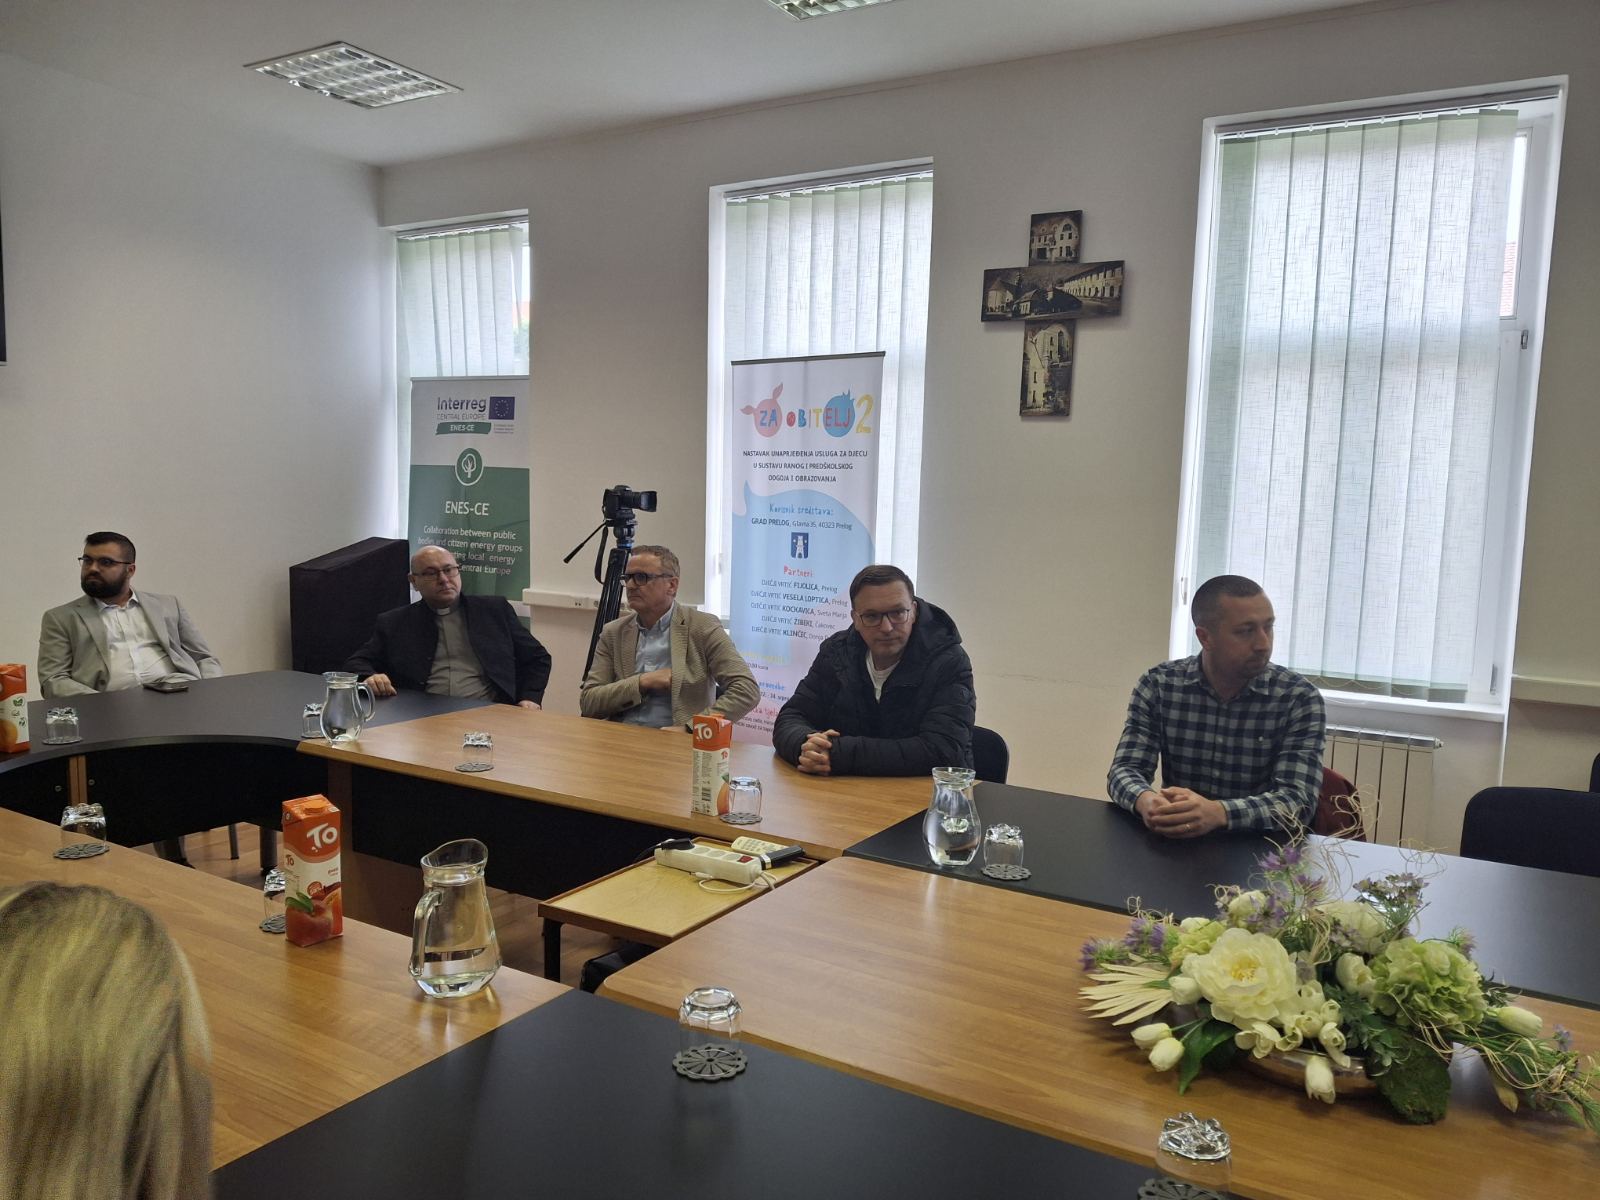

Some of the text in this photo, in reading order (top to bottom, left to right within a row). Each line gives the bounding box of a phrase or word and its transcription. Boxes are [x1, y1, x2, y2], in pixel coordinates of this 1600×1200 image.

[437, 397, 487, 412] Interreg
[760, 409, 778, 428] ZA
[856, 394, 875, 434] 2
[450, 424, 475, 432] ENES-CE
[445, 501, 491, 515] ENES-CE
[768, 519, 792, 527] PRELOG,
[423, 525, 516, 541] Collaboration between public
[447, 539, 468, 548] citizen
[470, 542, 495, 551] energy
[497, 544, 523, 554] groups
[468, 552, 485, 561] local
[489, 555, 516, 565] energy
[484, 566, 511, 576] Europe
[782, 593, 804, 601] VESELA
